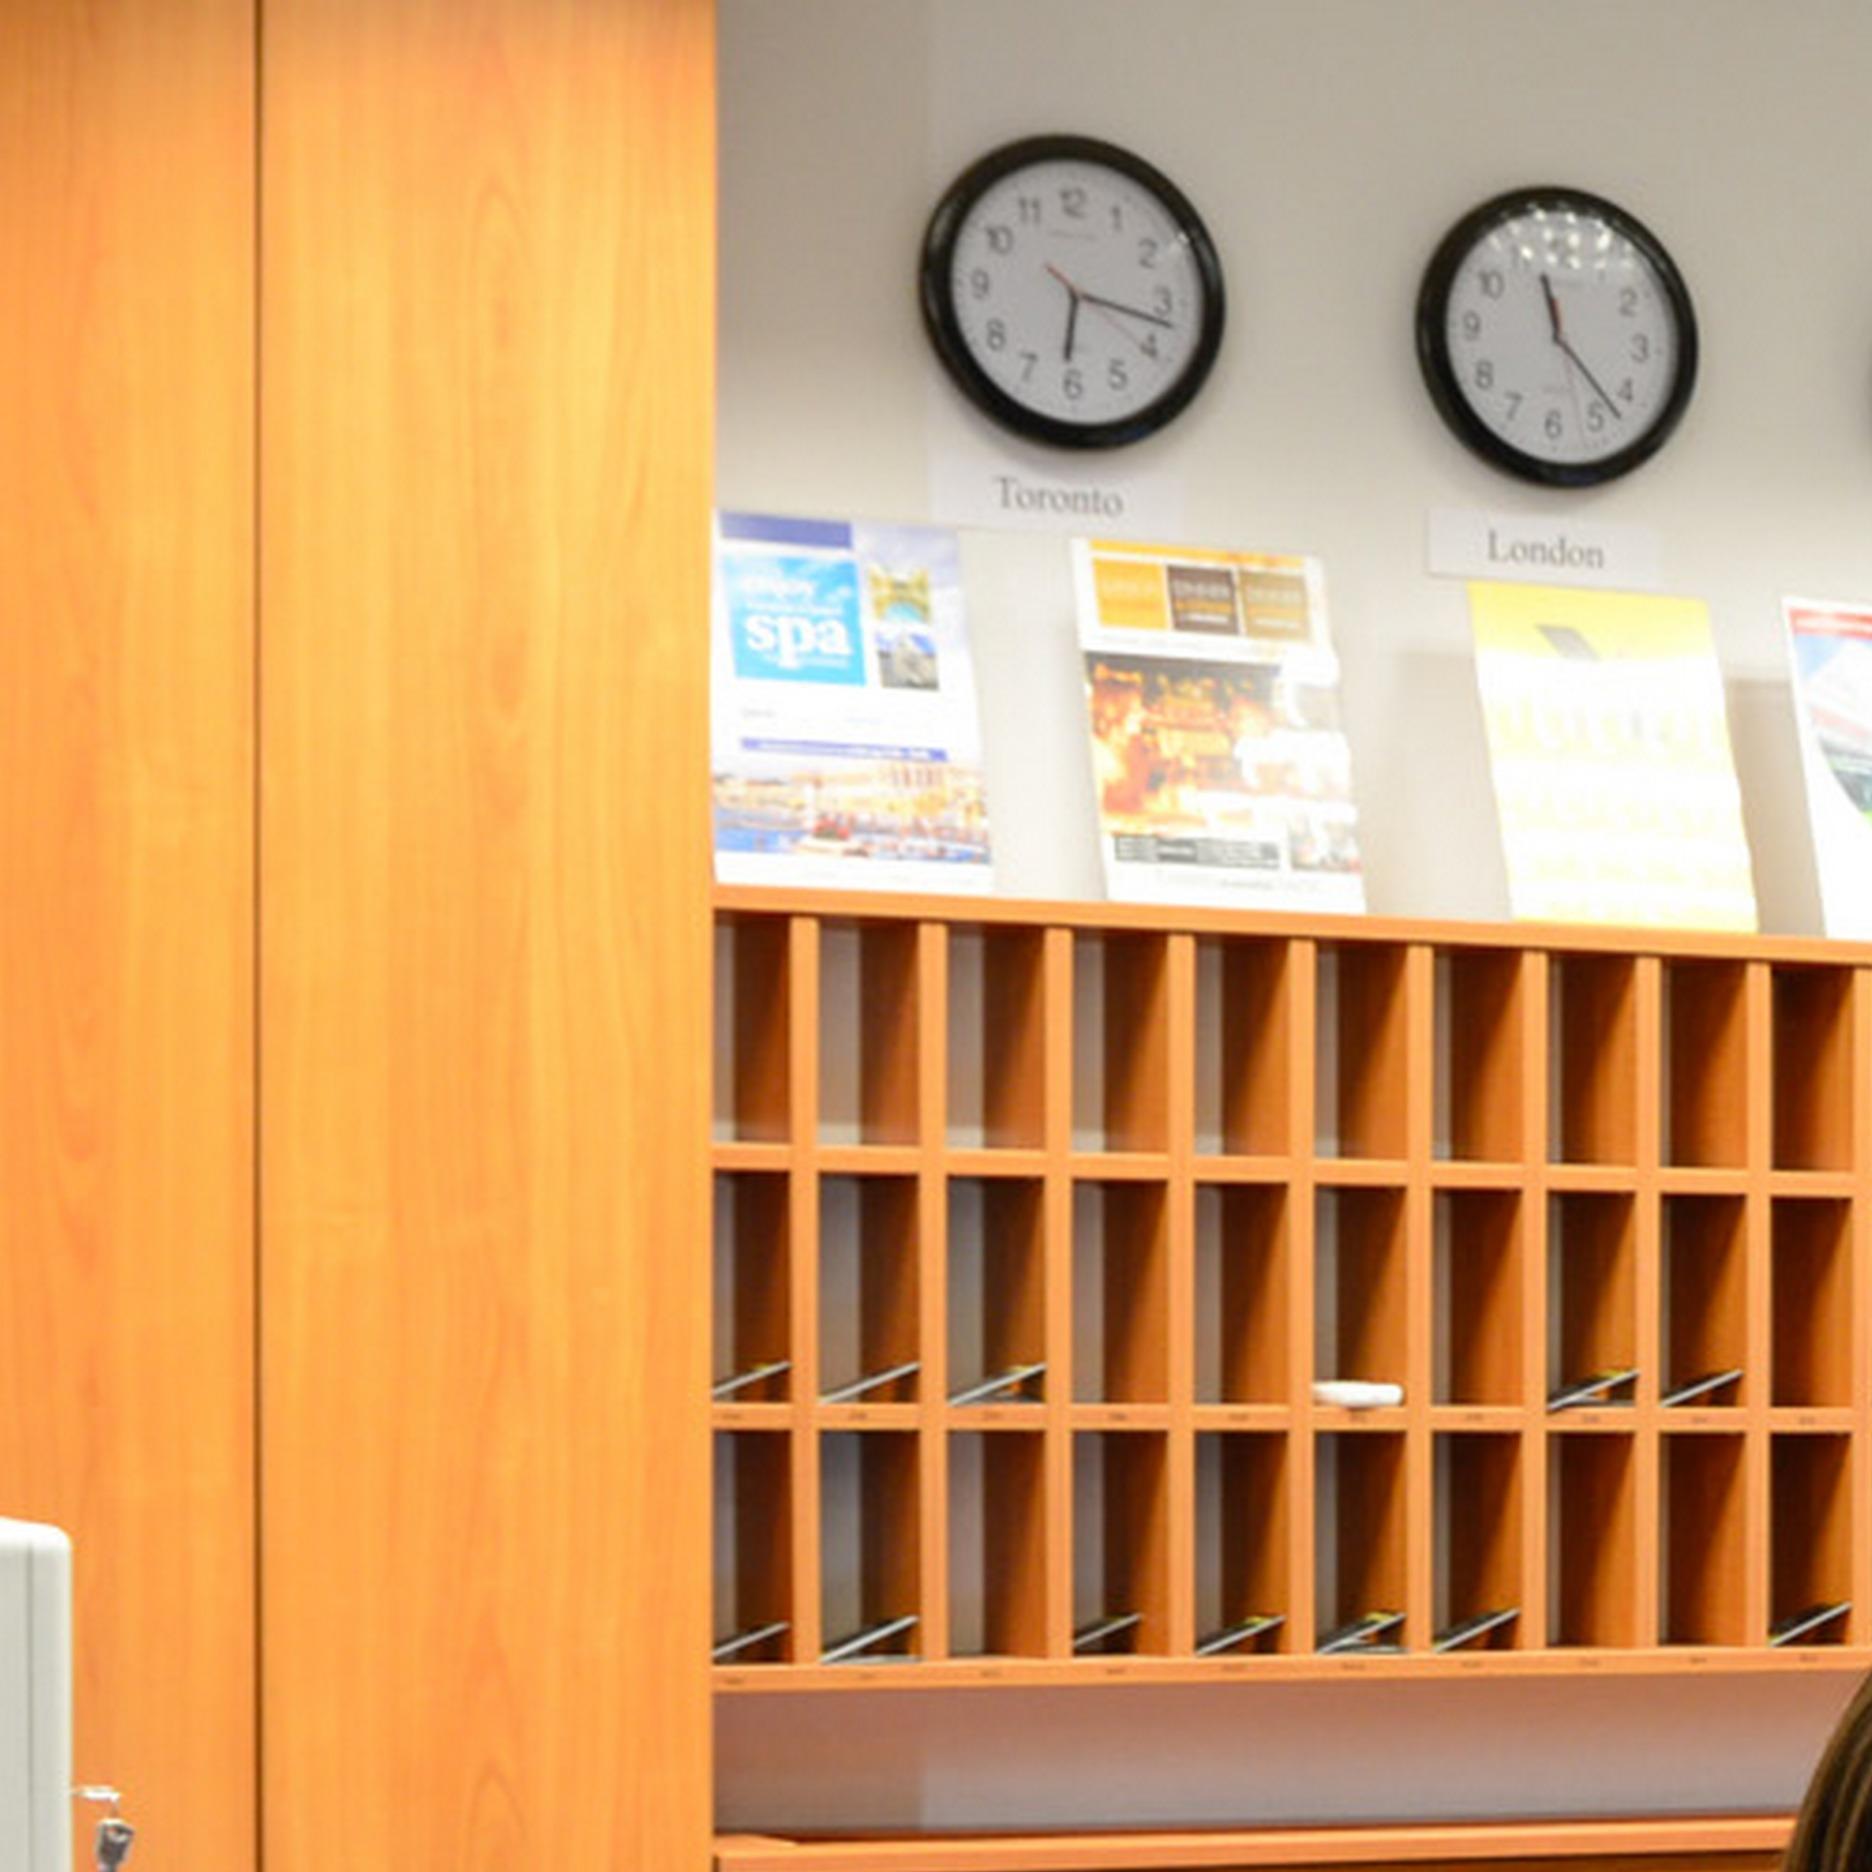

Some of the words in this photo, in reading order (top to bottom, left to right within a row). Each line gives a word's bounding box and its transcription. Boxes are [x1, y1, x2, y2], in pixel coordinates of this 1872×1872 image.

[1018, 196, 1042, 225] 11
[1059, 187, 1086, 218] 12
[1111, 204, 1122, 232] 1
[985, 225, 1013, 255] 10
[1138, 238, 1158, 269] 2
[970, 267, 989, 299] 9
[1479, 269, 1504, 300] 10
[1153, 285, 1172, 316] 3
[1619, 286, 1638, 319] 2
[986, 318, 1006, 352] 8
[1462, 309, 1481, 341] 9
[1139, 333, 1157, 359] 4
[1630, 333, 1650, 364] 3
[1018, 350, 1038, 382] 7
[1107, 358, 1128, 390] 5
[1475, 359, 1494, 391] 8
[1062, 368, 1083, 400] 6
[1617, 377, 1633, 403] 4
[1504, 390, 1523, 421] 7
[1587, 400, 1604, 433] 5
[1544, 409, 1563, 439] 6
[992, 474, 1125, 518] Toronto
[1486, 527, 1606, 569] London
[745, 612, 851, 669] spa
